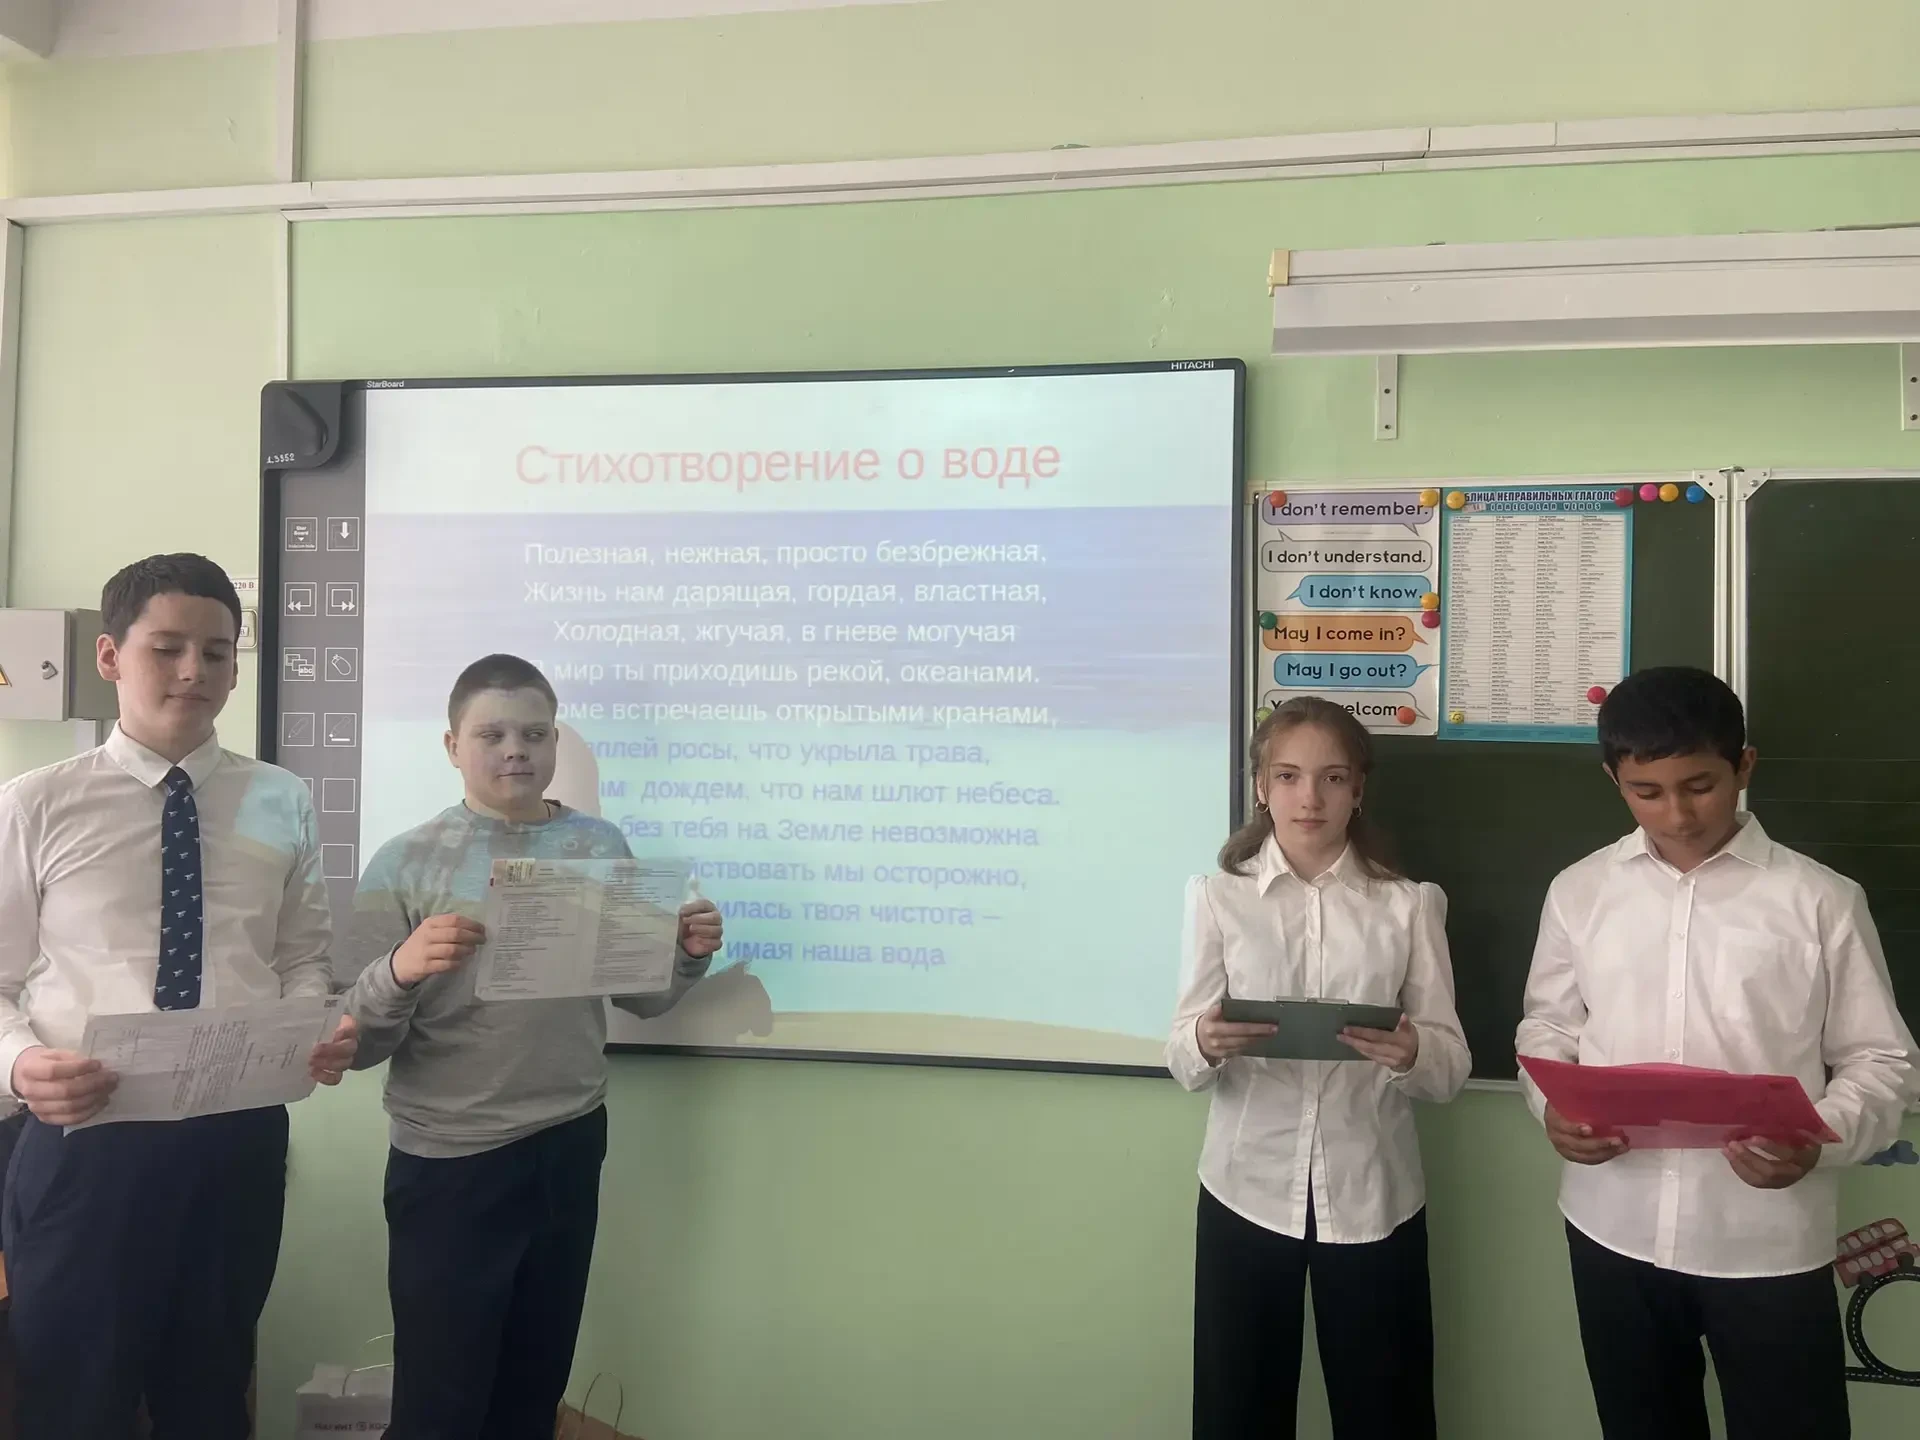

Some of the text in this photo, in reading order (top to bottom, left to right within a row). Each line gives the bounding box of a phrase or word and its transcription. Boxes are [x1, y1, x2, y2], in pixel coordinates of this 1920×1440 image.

[1171, 360, 1214, 370] HITACHI
[366, 380, 405, 388] StarBoard
[516, 444, 1061, 493] Стихотворение о воде
[1281, 502, 1327, 516] don't
[1331, 501, 1429, 516] remember.
[1464, 490, 1616, 504] БЛИЦА НЕПРАВИЛЬНЫХ ГЛАГОЛО
[524, 539, 1047, 570] Полезная, нежная, просто безбрежная,
[1268, 550, 1426, 563] I don't understand.
[524, 580, 1047, 608] Жизнь нам дарящая, гордая, властная,
[1309, 585, 1423, 599] I don't know.
[553, 620, 1016, 648] Холодная, жгучая, в гневе могучая
[1274, 626, 1406, 643] May I come in?
[554, 663, 604, 686] мир
[611, 663, 645, 682] ты
[653, 662, 798, 688] приходишь
[807, 659, 891, 688] рекой,
[900, 663, 1041, 684] океанами.
[1287, 662, 1407, 680] May I go out?
[557, 702, 1057, 730] оме встречаешь открытыми кранами,
[1344, 701, 1406, 716] elcom
[587, 736, 991, 768] плей росы, что укрыла трава,
[761, 782, 804, 801] что
[812, 782, 864, 803] нам
[871, 783, 949, 804] шлют
[618, 814, 662, 839] без
[672, 815, 729, 840] тебя
[737, 821, 769, 841] на
[777, 818, 864, 842] Земле
[871, 825, 1039, 846] невозможна
[824, 863, 864, 882] мы
[873, 864, 1027, 892] осторожно,
[801, 902, 861, 922] твоя
[870, 903, 974, 927] чистота
[802, 942, 874, 964] наша
[881, 944, 947, 973] вода
